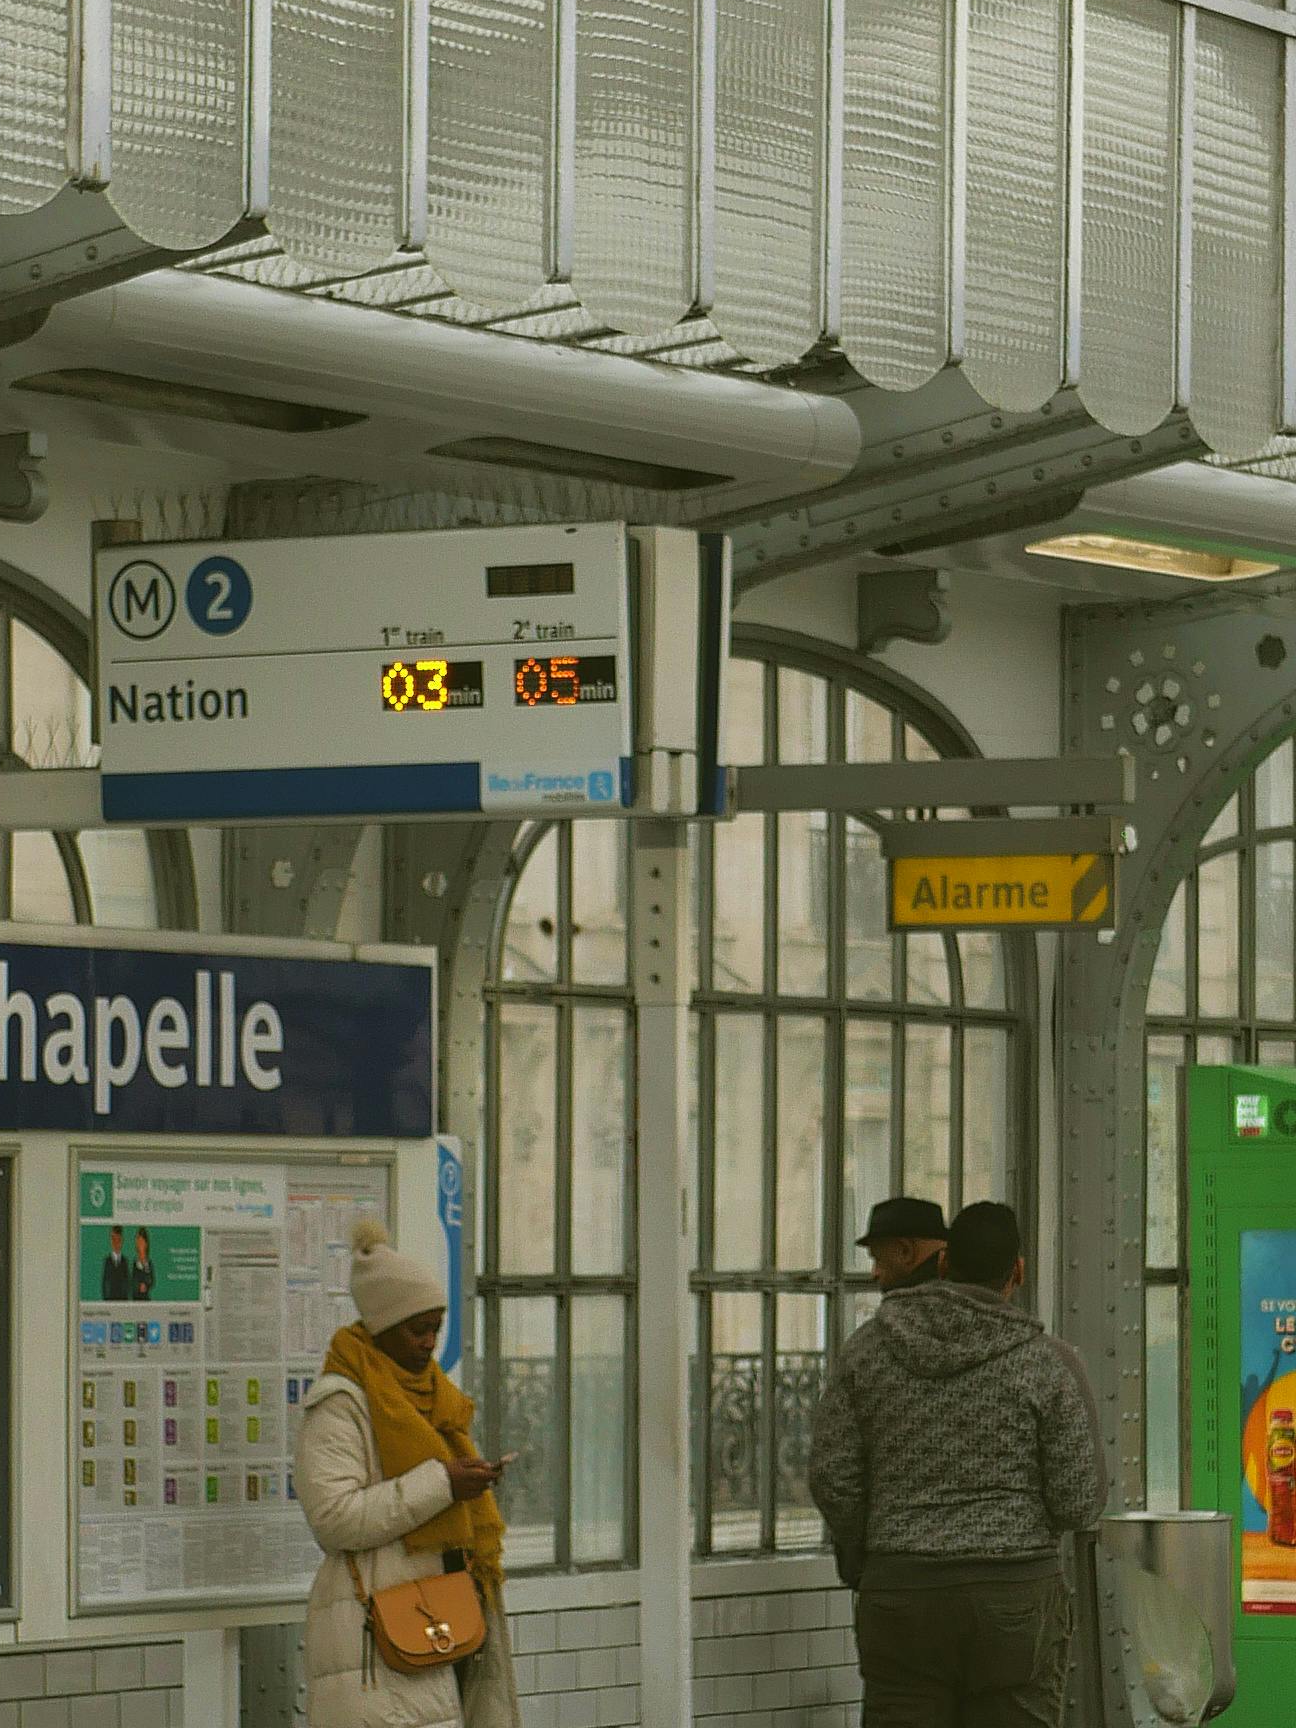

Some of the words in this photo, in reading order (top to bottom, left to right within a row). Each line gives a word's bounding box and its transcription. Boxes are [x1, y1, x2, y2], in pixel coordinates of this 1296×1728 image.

[204, 571, 234, 621] 2
[406, 628, 444, 645] train
[536, 622, 575, 640] train
[382, 660, 448, 712] 03
[448, 685, 481, 706] min
[515, 655, 580, 707] 05
[580, 680, 614, 702] min
[108, 682, 249, 725] Nation
[911, 874, 1050, 911] Alarme
[1260, 1300, 1274, 1313] SI
[1275, 1316, 1296, 1334] LE
